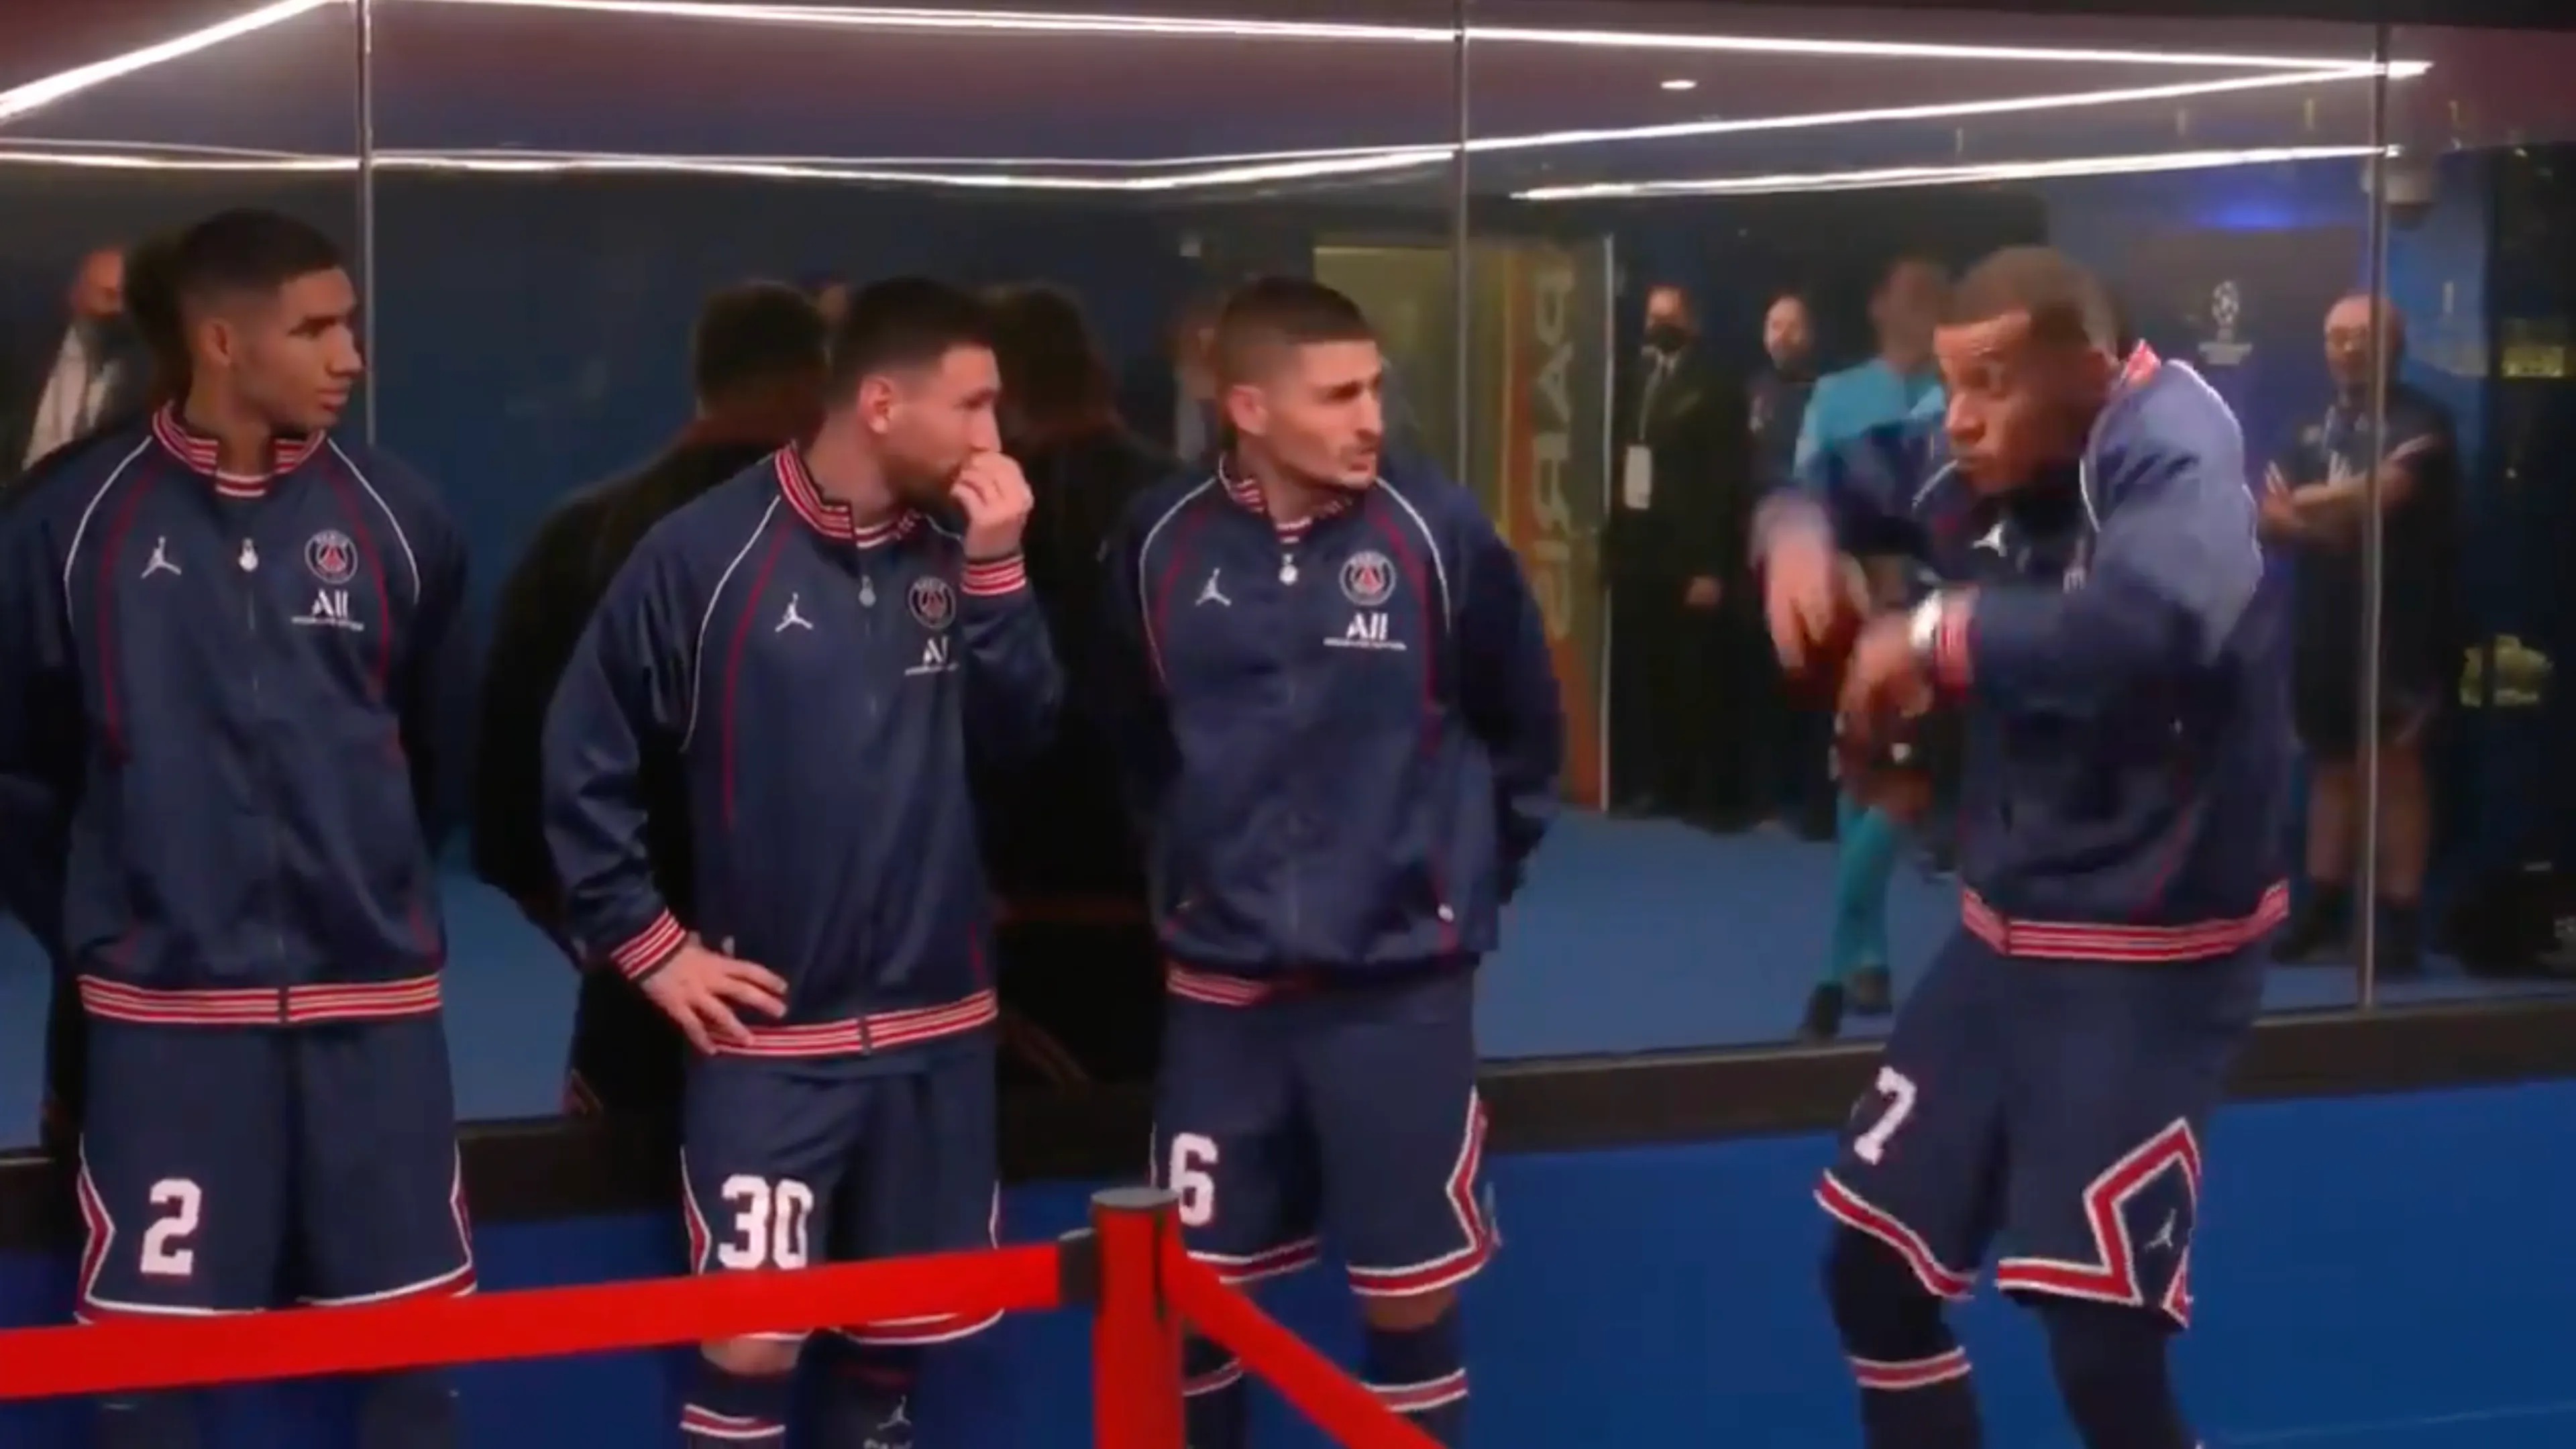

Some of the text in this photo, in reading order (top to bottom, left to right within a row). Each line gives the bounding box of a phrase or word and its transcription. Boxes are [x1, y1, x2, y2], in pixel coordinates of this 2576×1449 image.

[1854, 1065, 1917, 1165] 7
[141, 1178, 201, 1275] 2
[718, 1174, 814, 1270] 30
[1170, 1132, 1218, 1227] 6
